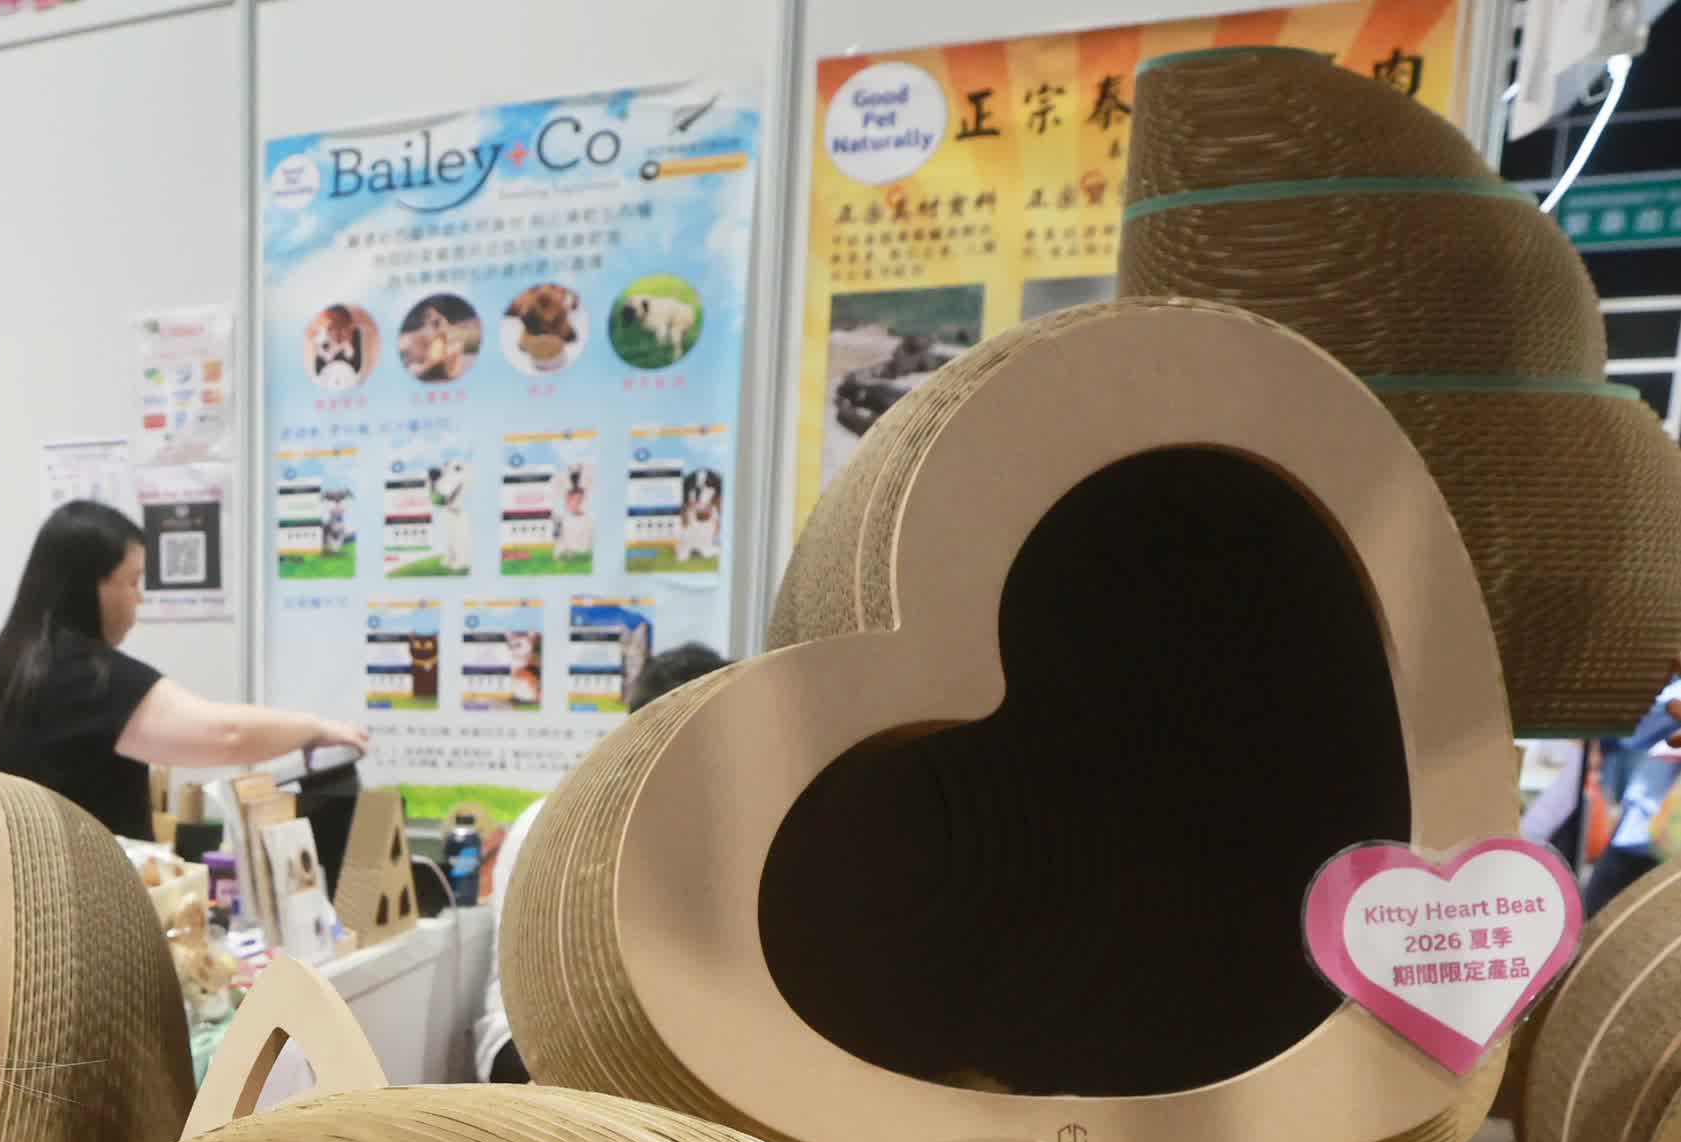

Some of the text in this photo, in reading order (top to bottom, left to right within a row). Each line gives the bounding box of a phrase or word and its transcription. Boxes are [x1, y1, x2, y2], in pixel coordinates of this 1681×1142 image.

[852, 84, 911, 108] Good
[862, 111, 897, 128] Pet
[831, 131, 935, 154] Naturally
[328, 117, 621, 213] Bailey Co
[1364, 896, 1546, 926] Kitty Heart Beat
[1404, 926, 1513, 953] 2026 夏季
